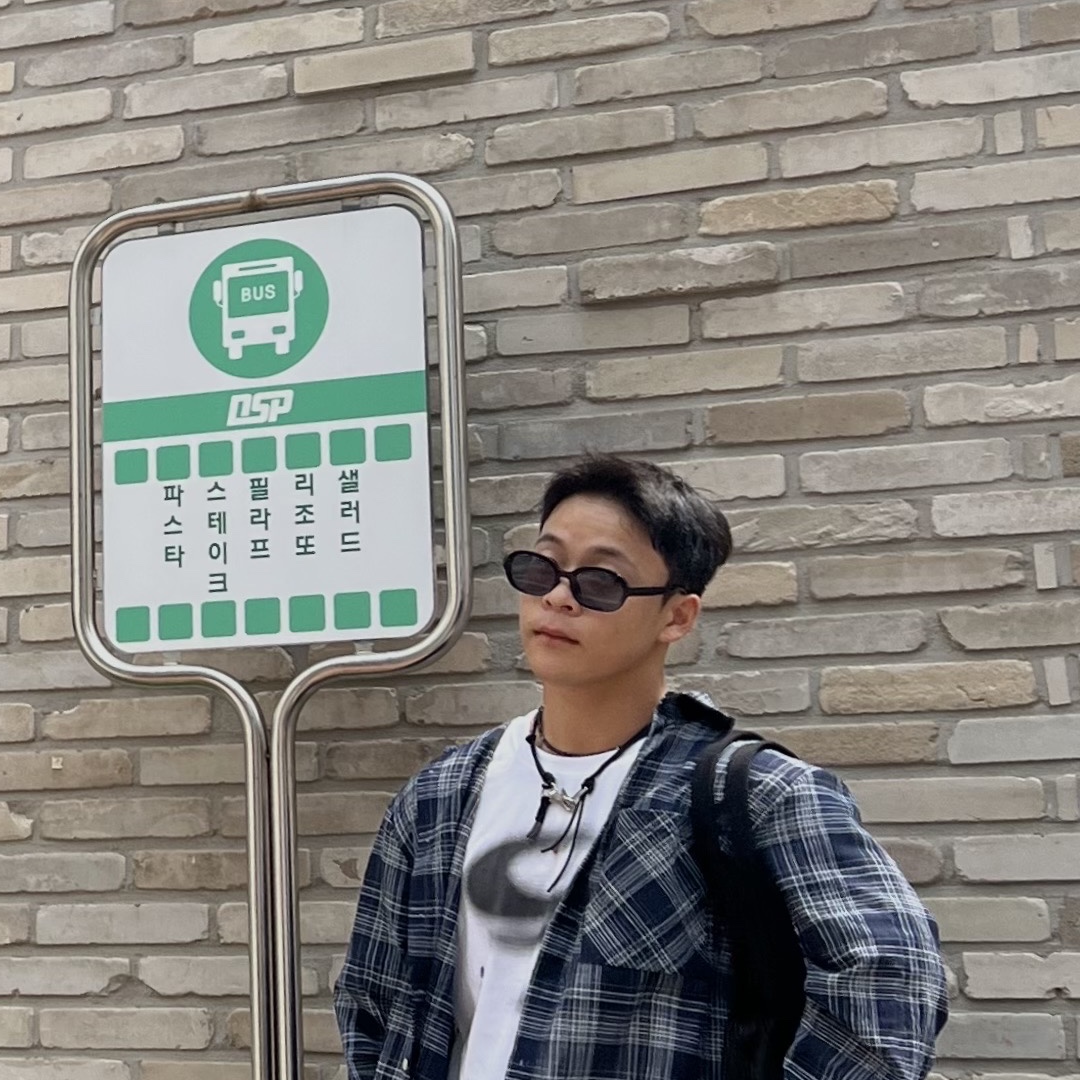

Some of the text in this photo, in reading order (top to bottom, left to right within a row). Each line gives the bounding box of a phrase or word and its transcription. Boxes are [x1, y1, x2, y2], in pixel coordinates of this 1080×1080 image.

[240, 283, 277, 303] BUS
[162, 484, 186, 569] 파스타
[206, 480, 229, 594] 스테이크
[248, 476, 272, 560] 필라프
[293, 472, 316, 556] 리조또
[337, 468, 362, 554] 샐러드
